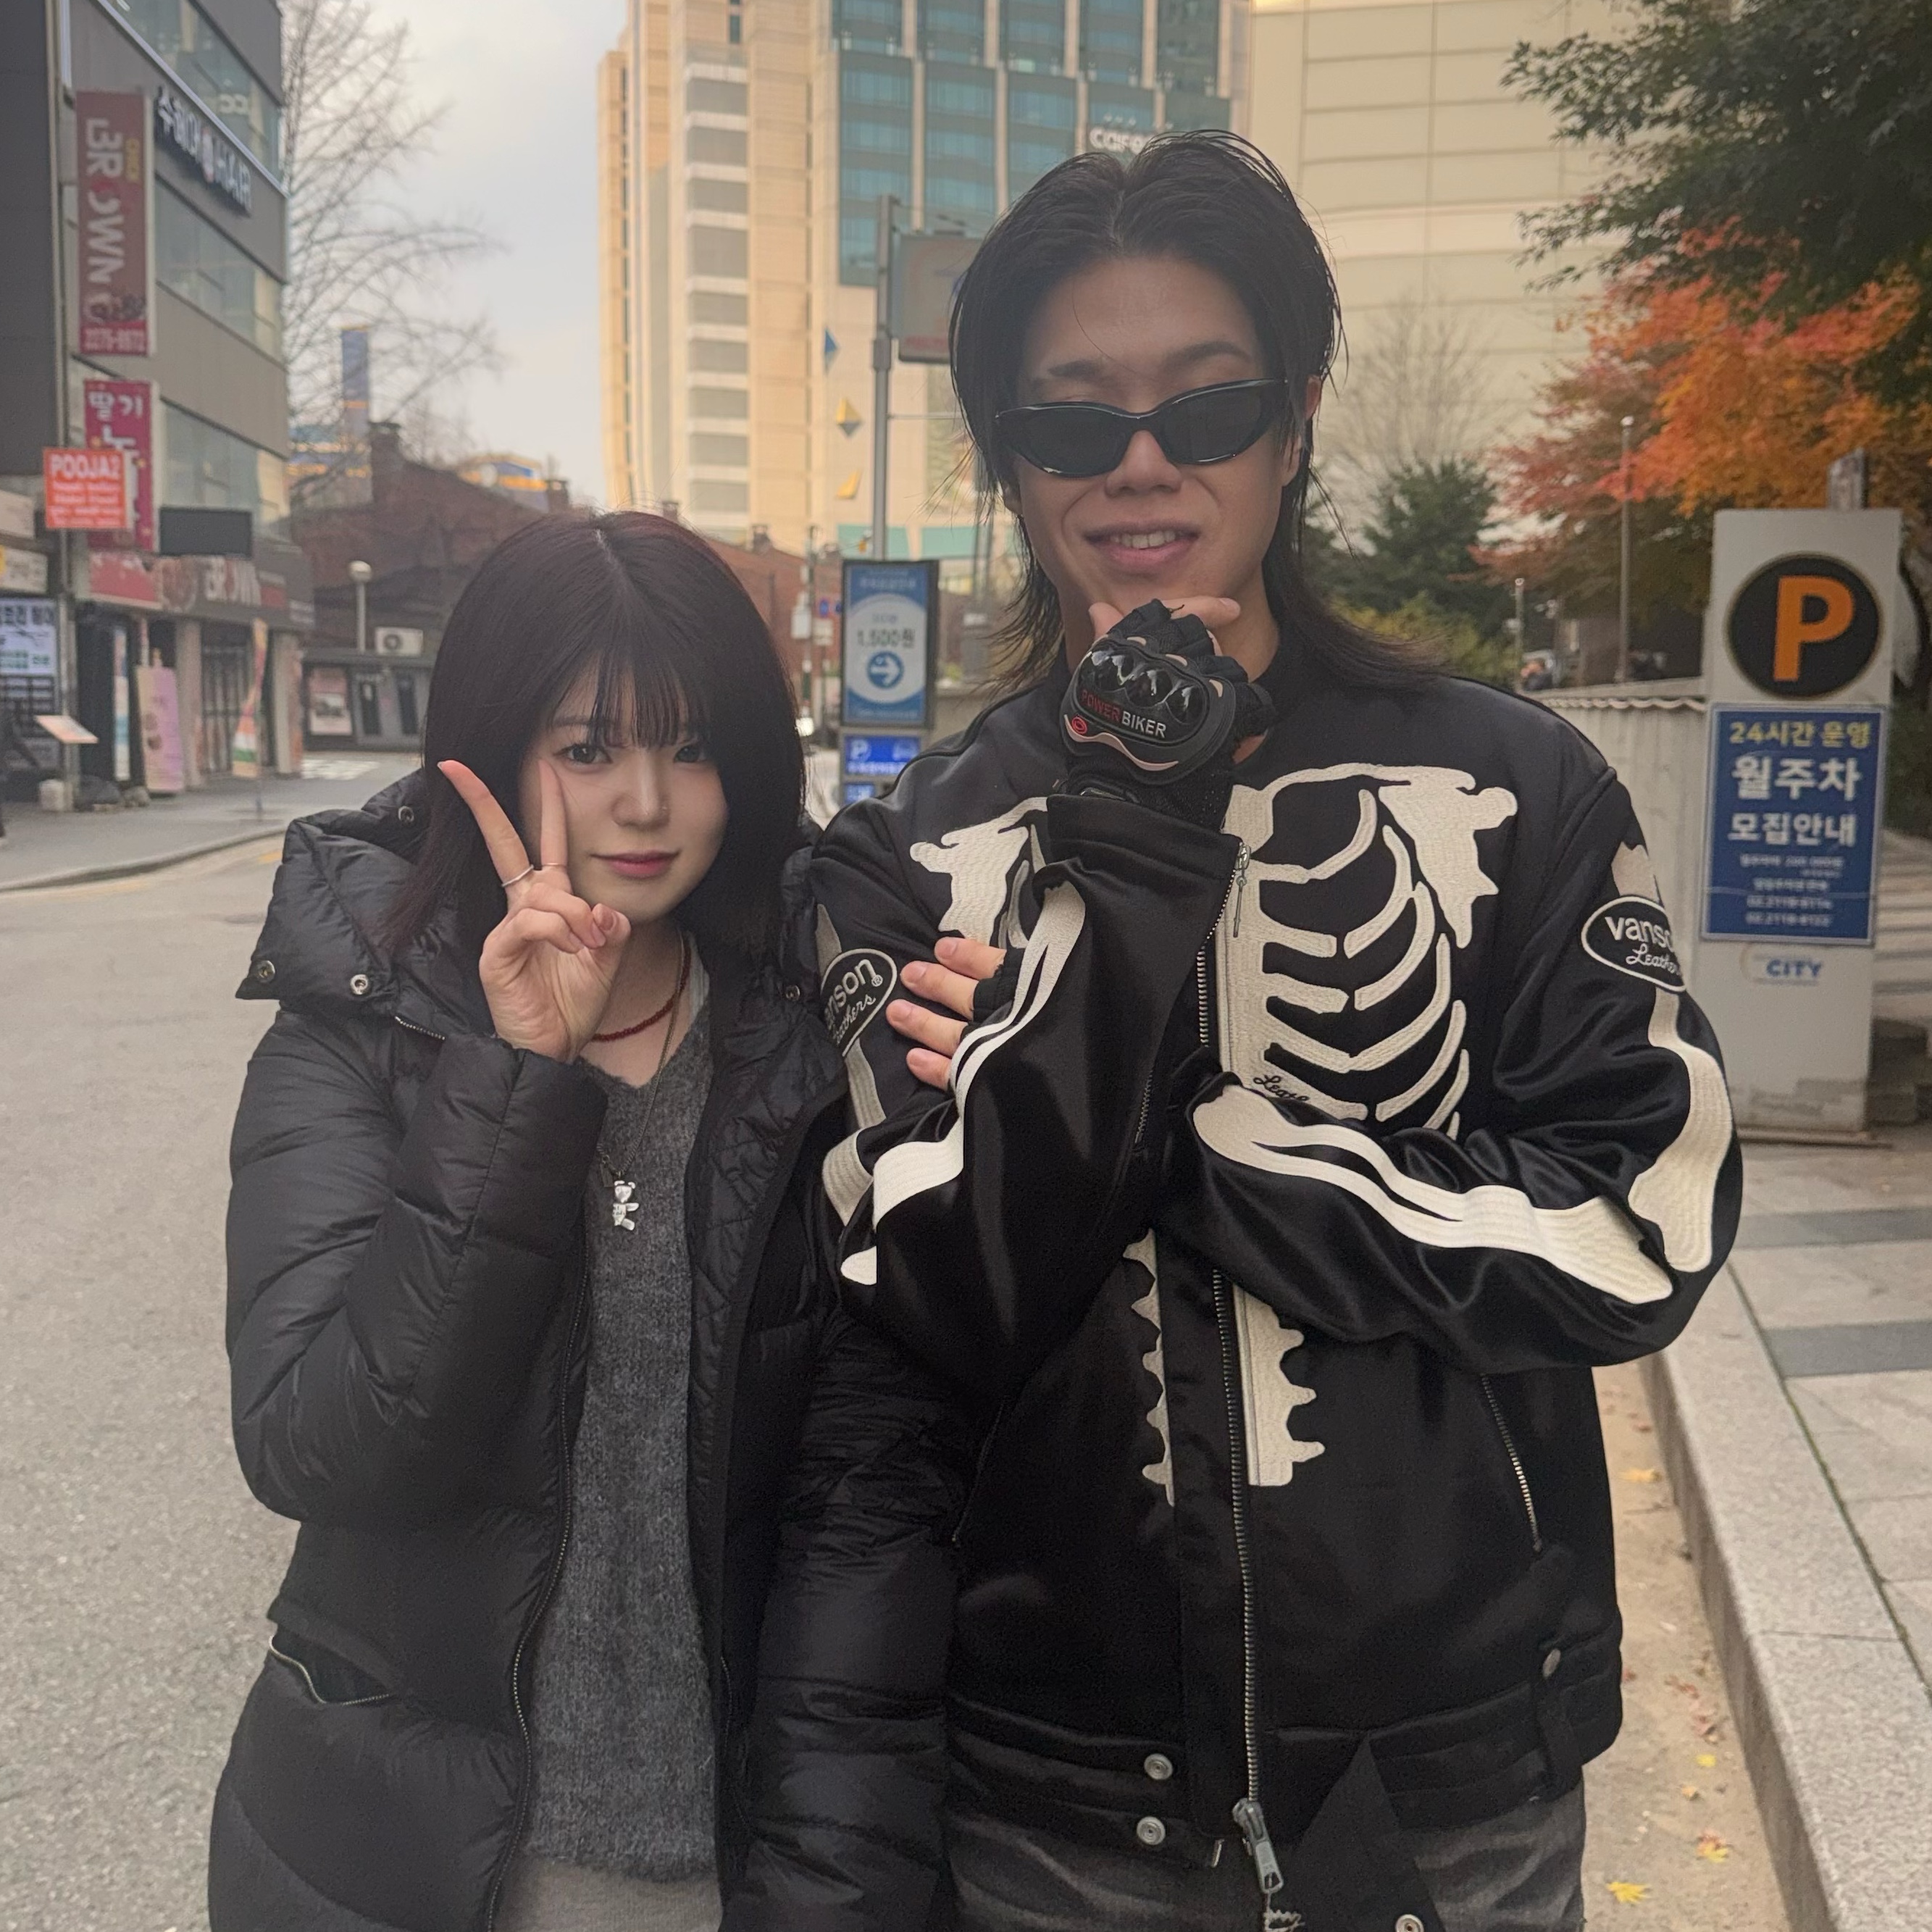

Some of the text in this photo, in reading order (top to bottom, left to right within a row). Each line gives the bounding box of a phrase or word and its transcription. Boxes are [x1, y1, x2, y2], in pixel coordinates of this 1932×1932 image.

[1773, 574, 1854, 682] P
[1081, 689, 1167, 738] POWER BIKER
[1728, 720, 1872, 750] 24시간 운영
[1731, 755, 1863, 801] 월주차
[1727, 811, 1857, 847] 모집안내
[1766, 959, 1824, 978] CITY
